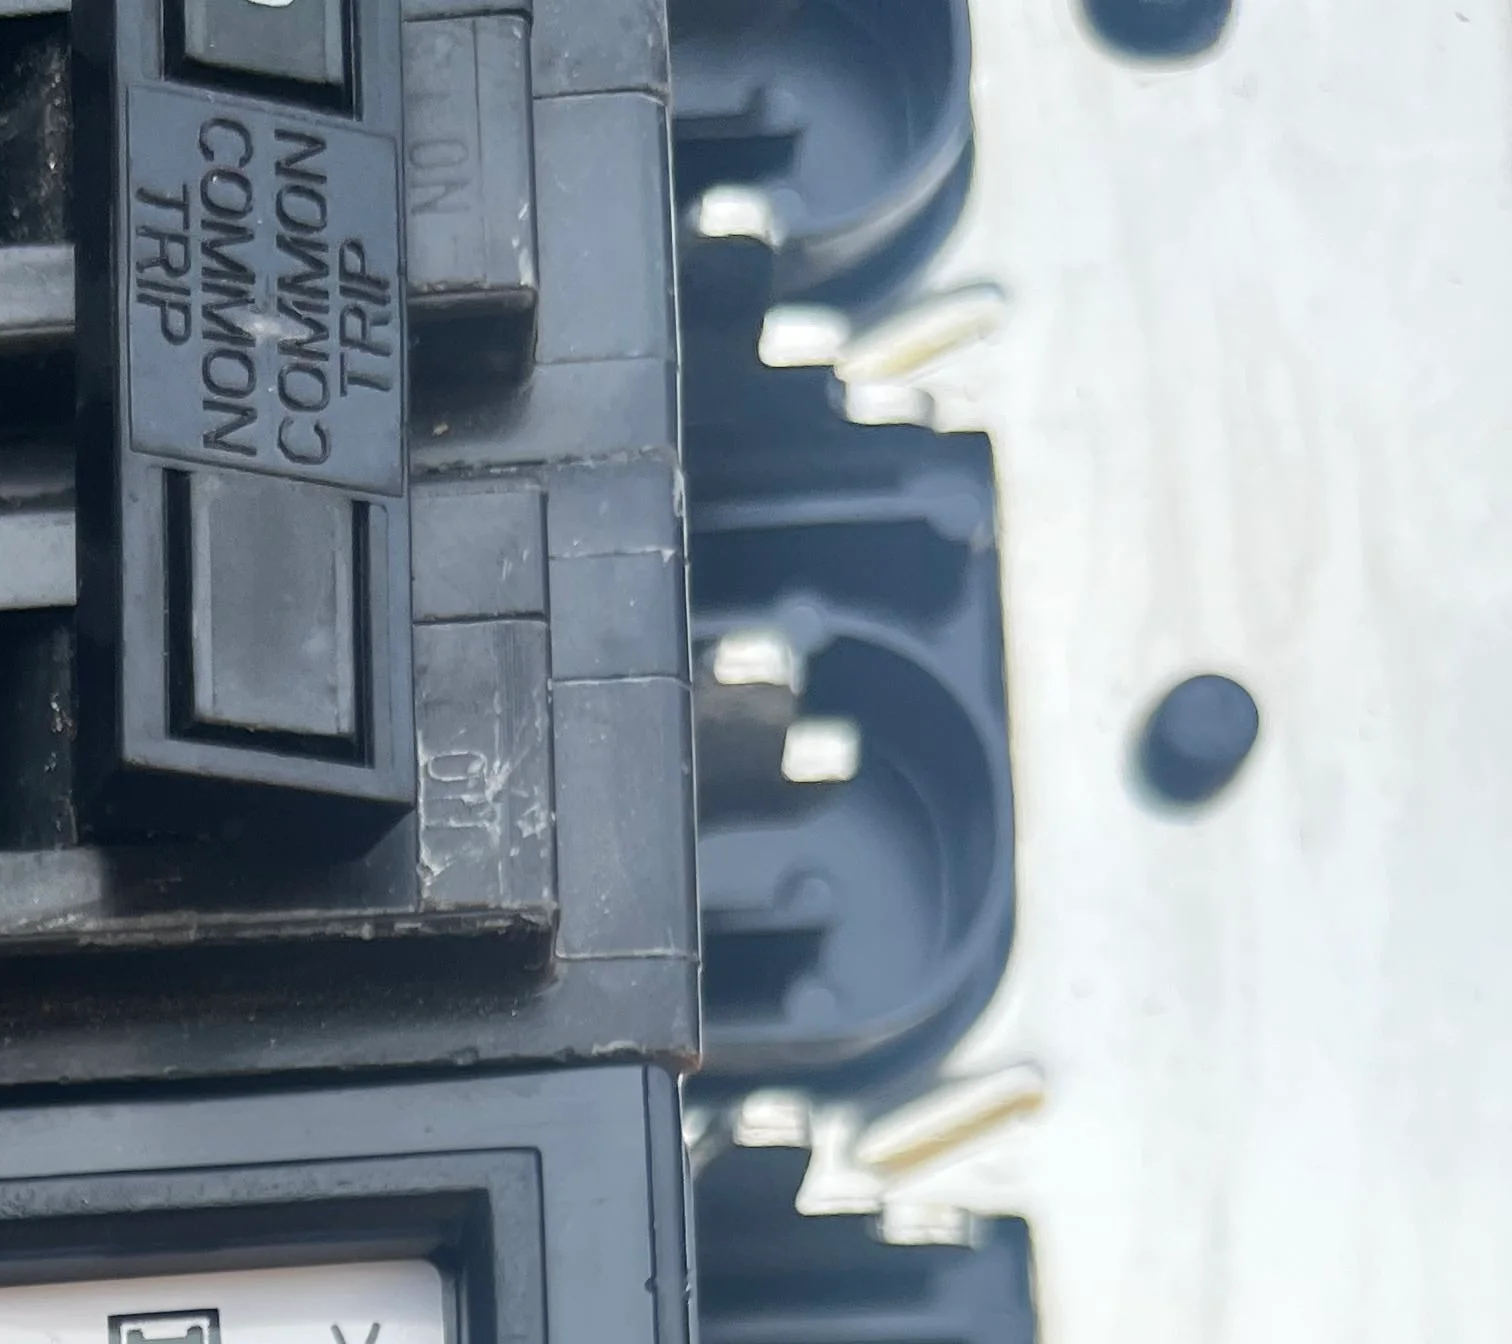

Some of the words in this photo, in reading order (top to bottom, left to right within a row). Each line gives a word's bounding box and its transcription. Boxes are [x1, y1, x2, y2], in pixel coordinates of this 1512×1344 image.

[135, 183, 192, 346] TRIP
[199, 118, 258, 457] COMMON
[275, 129, 331, 466] COMMON
[338, 240, 394, 397] TRIP
